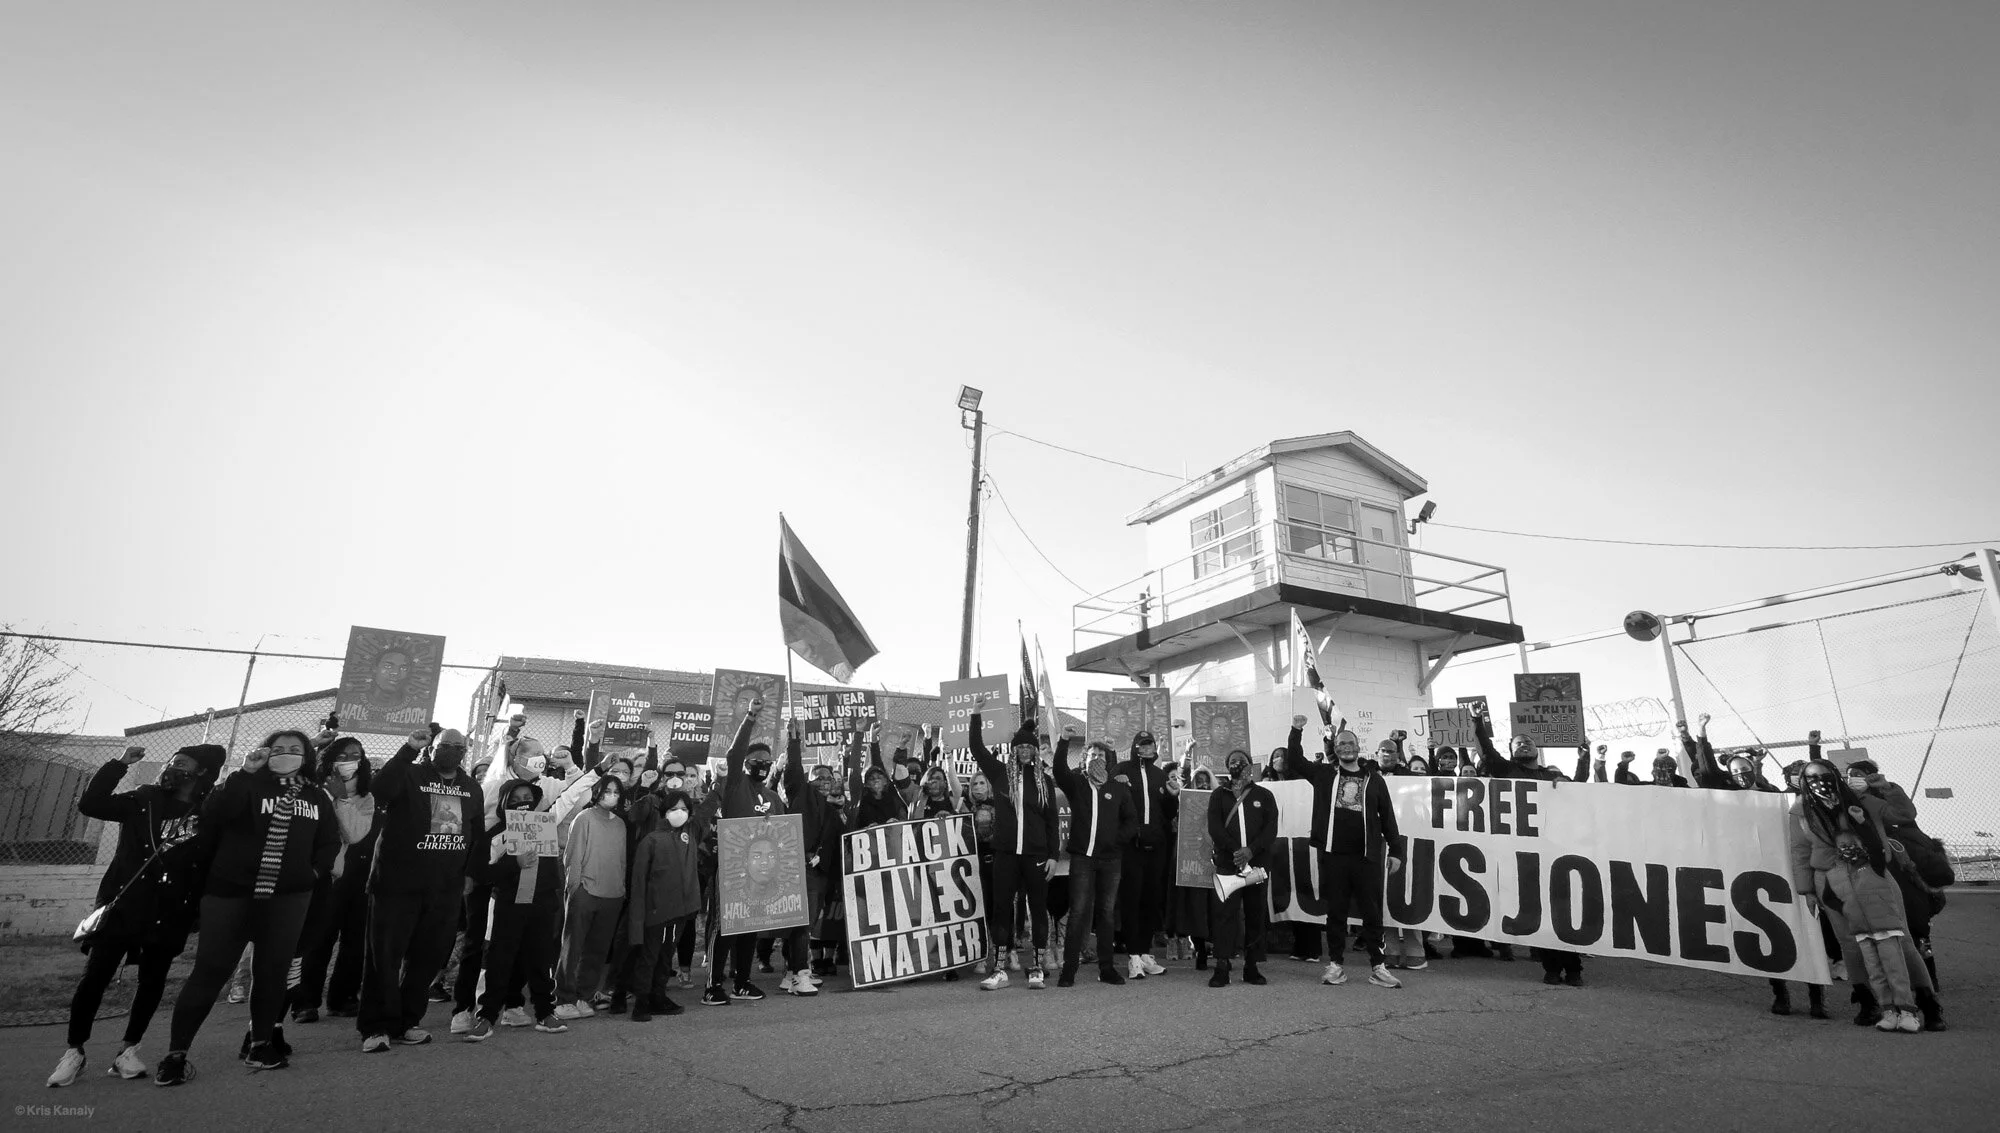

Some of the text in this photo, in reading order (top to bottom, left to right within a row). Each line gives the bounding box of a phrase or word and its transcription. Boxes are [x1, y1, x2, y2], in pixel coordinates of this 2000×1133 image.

[611, 698, 651, 708] TAINTED
[803, 692, 865, 707] NEW YEAR
[338, 703, 369, 721] WALK
[386, 707, 427, 724] FREEDOM
[618, 707, 643, 715] JURY
[674, 711, 711, 721] STAND
[804, 706, 829, 720] NEW
[831, 705, 876, 717] JUSTICE
[1533, 705, 1577, 714] TRUTH
[618, 714, 640, 723] AND
[821, 718, 852, 731] FREE
[1516, 714, 1577, 724] WILL SET
[673, 722, 696, 731] FOR
[1530, 723, 1578, 733] JULIUS
[671, 732, 710, 742] JULIUS
[805, 731, 844, 746] JULIUS
[1544, 733, 1579, 743] FREE
[1431, 777, 1539, 837] FREE
[424, 834, 465, 843] TYPE OF
[851, 817, 970, 872] BLACK
[416, 841, 467, 850] CHRISTIAN
[853, 858, 978, 937] LIVES
[723, 902, 750, 920] WALK
[766, 894, 802, 916] FREEDOM
[1501, 851, 1799, 974] JONES
[860, 920, 982, 983] MATTER
